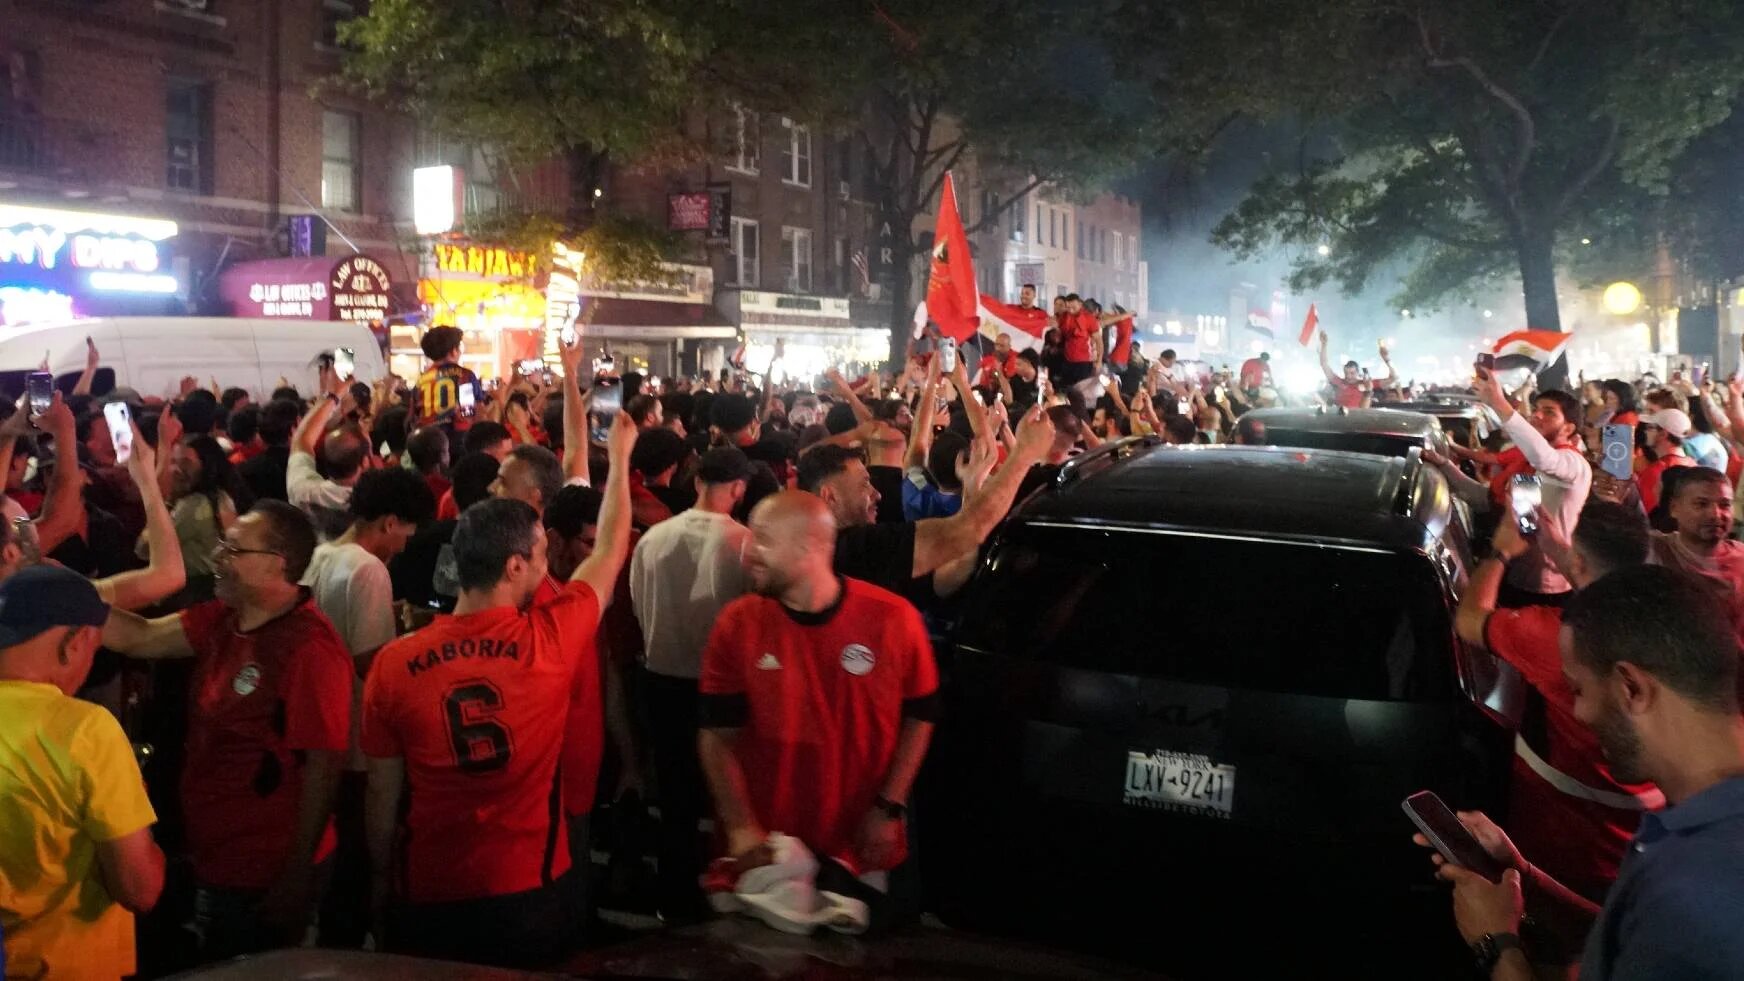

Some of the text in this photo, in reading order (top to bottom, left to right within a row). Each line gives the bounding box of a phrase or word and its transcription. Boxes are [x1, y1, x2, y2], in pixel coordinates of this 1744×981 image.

[332, 257, 390, 291] LAW OFFICES
[264, 284, 280, 302] LAW
[417, 369, 456, 417] 10
[406, 638, 519, 676] KABORIA
[441, 677, 515, 775] 6
[1180, 769, 1224, 802] 9241
